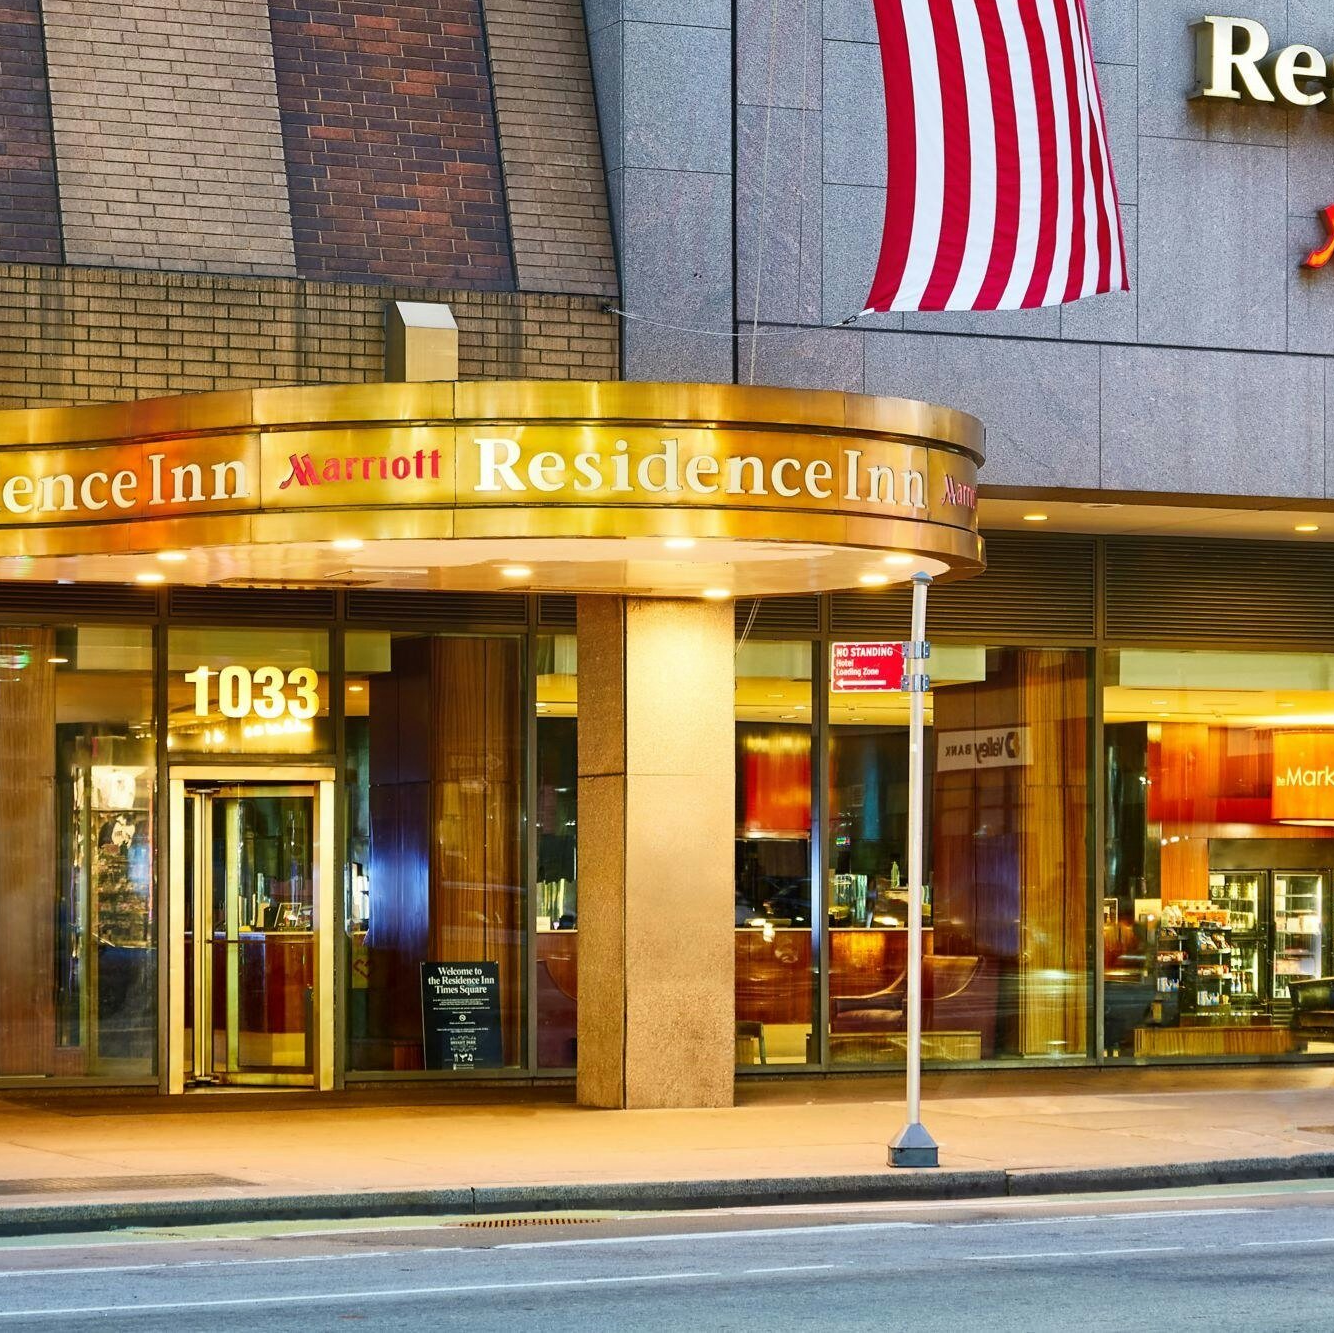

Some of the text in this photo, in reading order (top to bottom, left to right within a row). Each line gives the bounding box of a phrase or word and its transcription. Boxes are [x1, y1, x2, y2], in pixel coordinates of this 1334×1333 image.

[146, 453, 251, 506] Inn
[278, 448, 443, 490] Marriott
[473, 437, 834, 500] Residence
[843, 449, 927, 509] Inn
[836, 646, 894, 658] NO STANDING
[835, 659, 854, 667] Hotel
[835, 667, 880, 677] Loading Zone
[184, 665, 320, 719] 1033
[437, 967, 483, 976] Welcome to
[428, 975, 495, 985] the Residence Inn
[435, 985, 488, 996] Times Square
